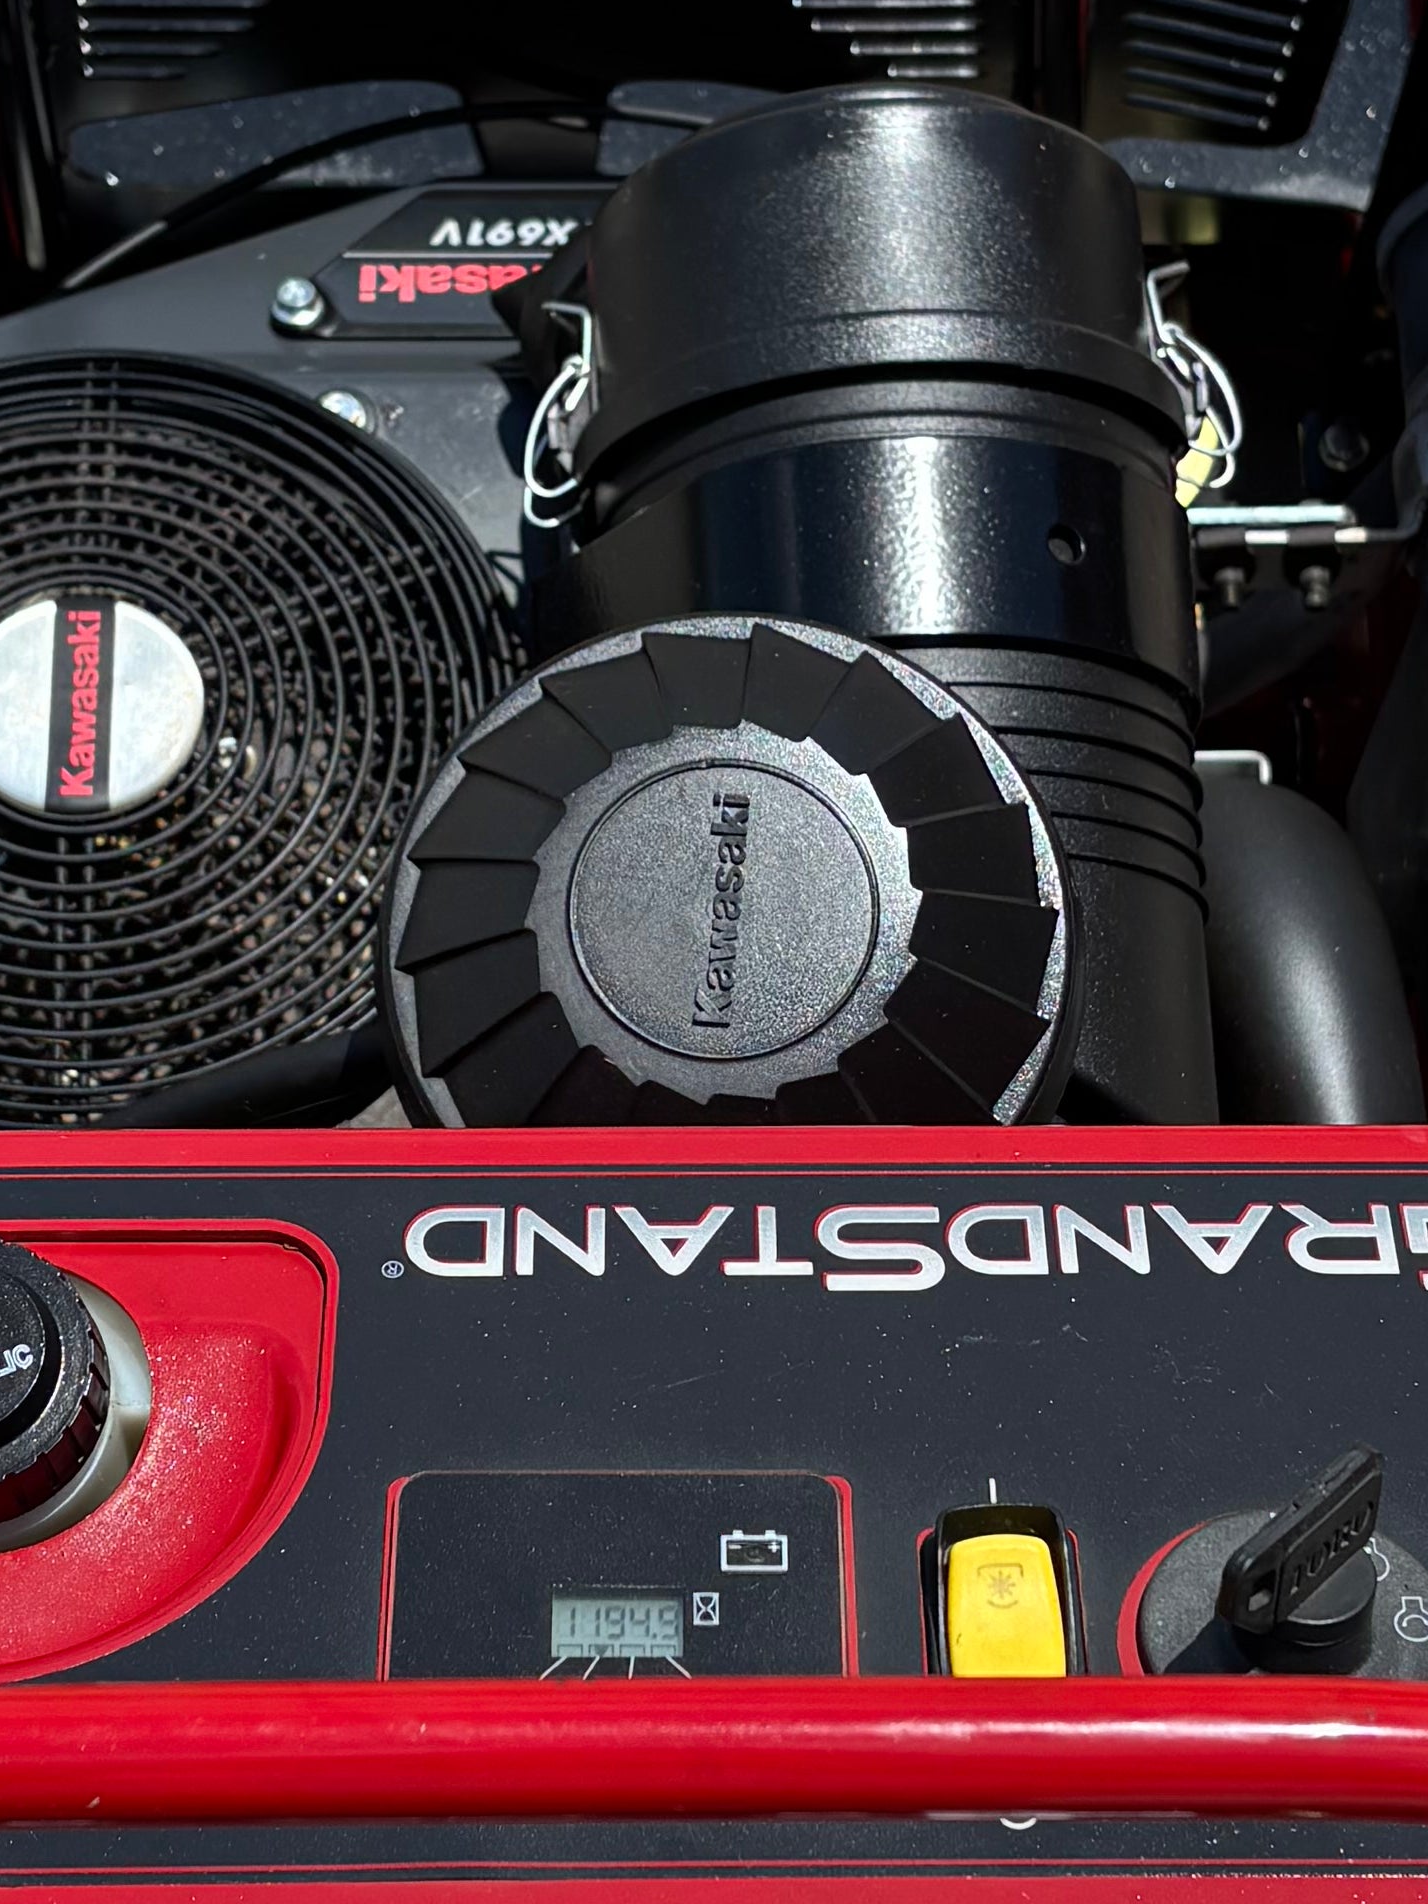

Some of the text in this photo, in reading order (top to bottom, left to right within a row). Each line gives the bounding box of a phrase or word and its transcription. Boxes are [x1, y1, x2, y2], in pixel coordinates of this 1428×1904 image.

[357, 264, 542, 304] asaki
[430, 218, 592, 247] X691V
[58, 609, 103, 798] Kawasaki
[690, 792, 751, 1030] Kawasaki
